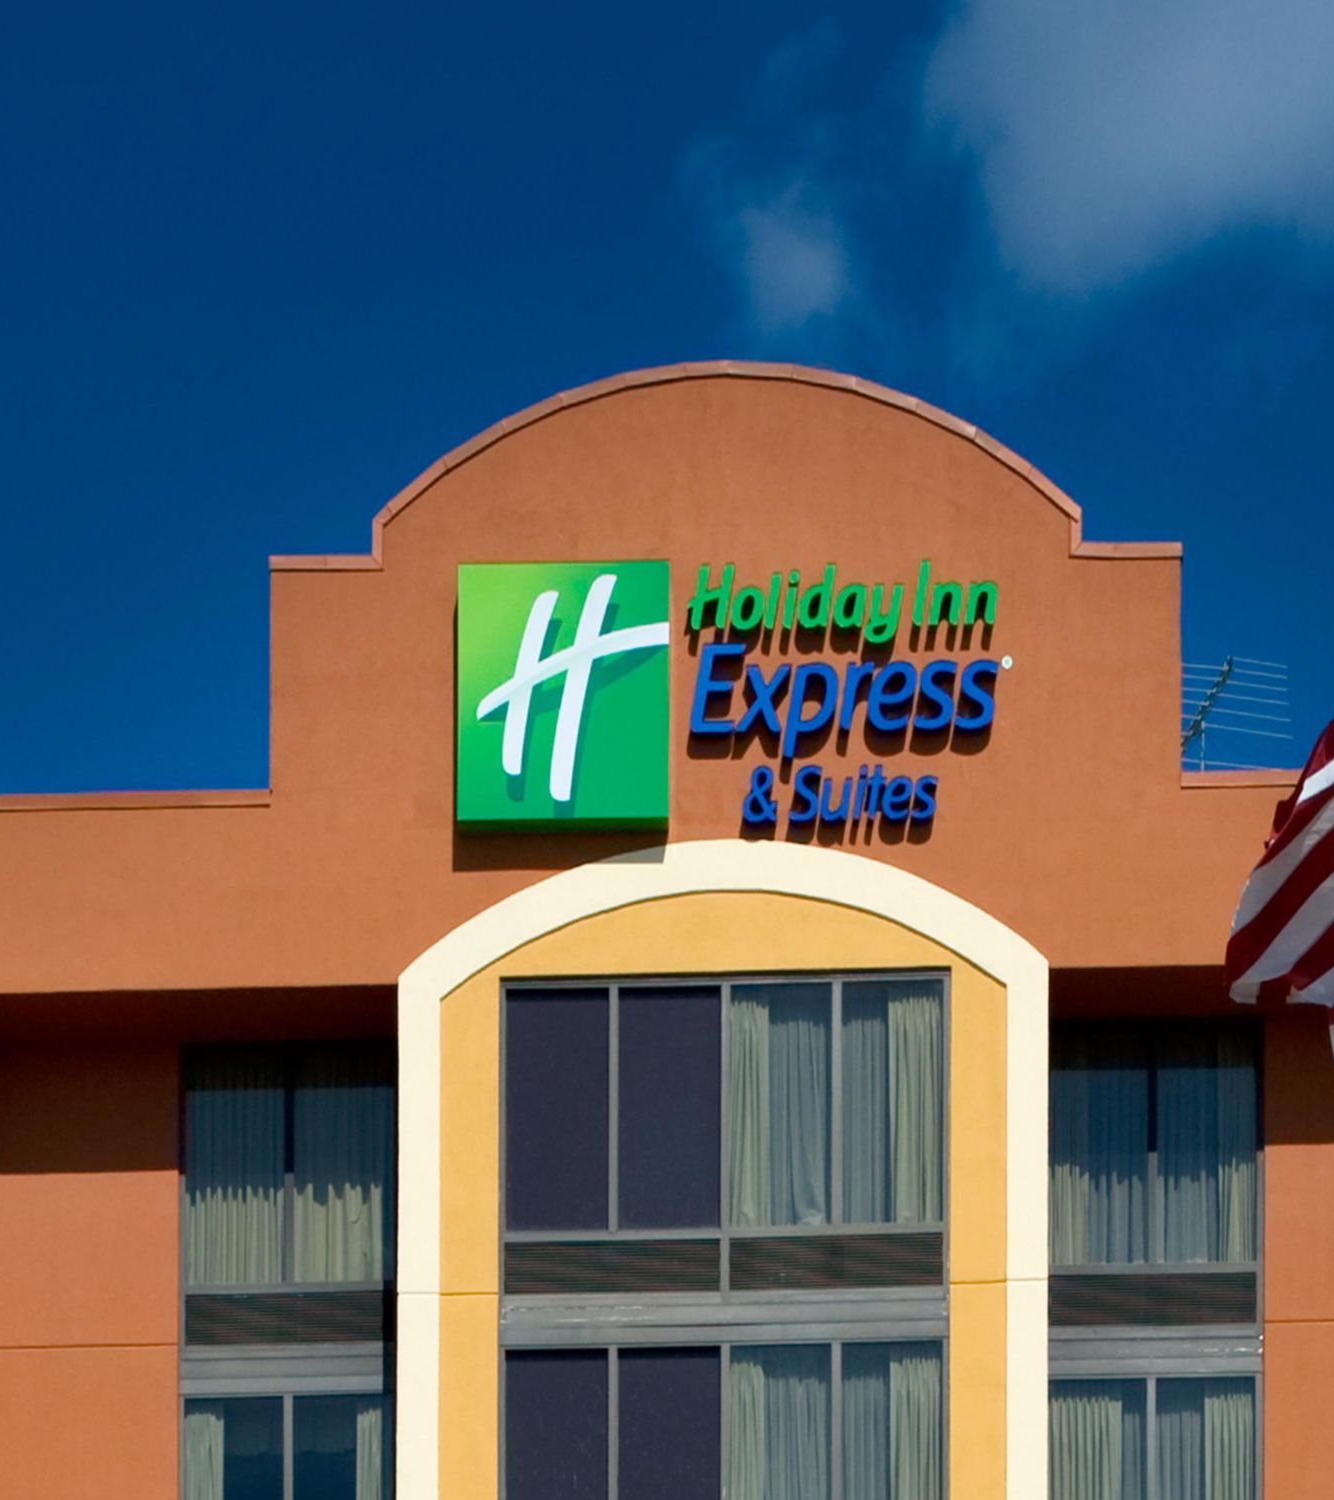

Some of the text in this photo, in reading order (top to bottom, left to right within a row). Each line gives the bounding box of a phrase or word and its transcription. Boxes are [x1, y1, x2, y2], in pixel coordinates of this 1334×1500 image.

[687, 559, 998, 643] Holiday Inn
[689, 642, 999, 758] Express
[742, 764, 939, 824] & Suites
